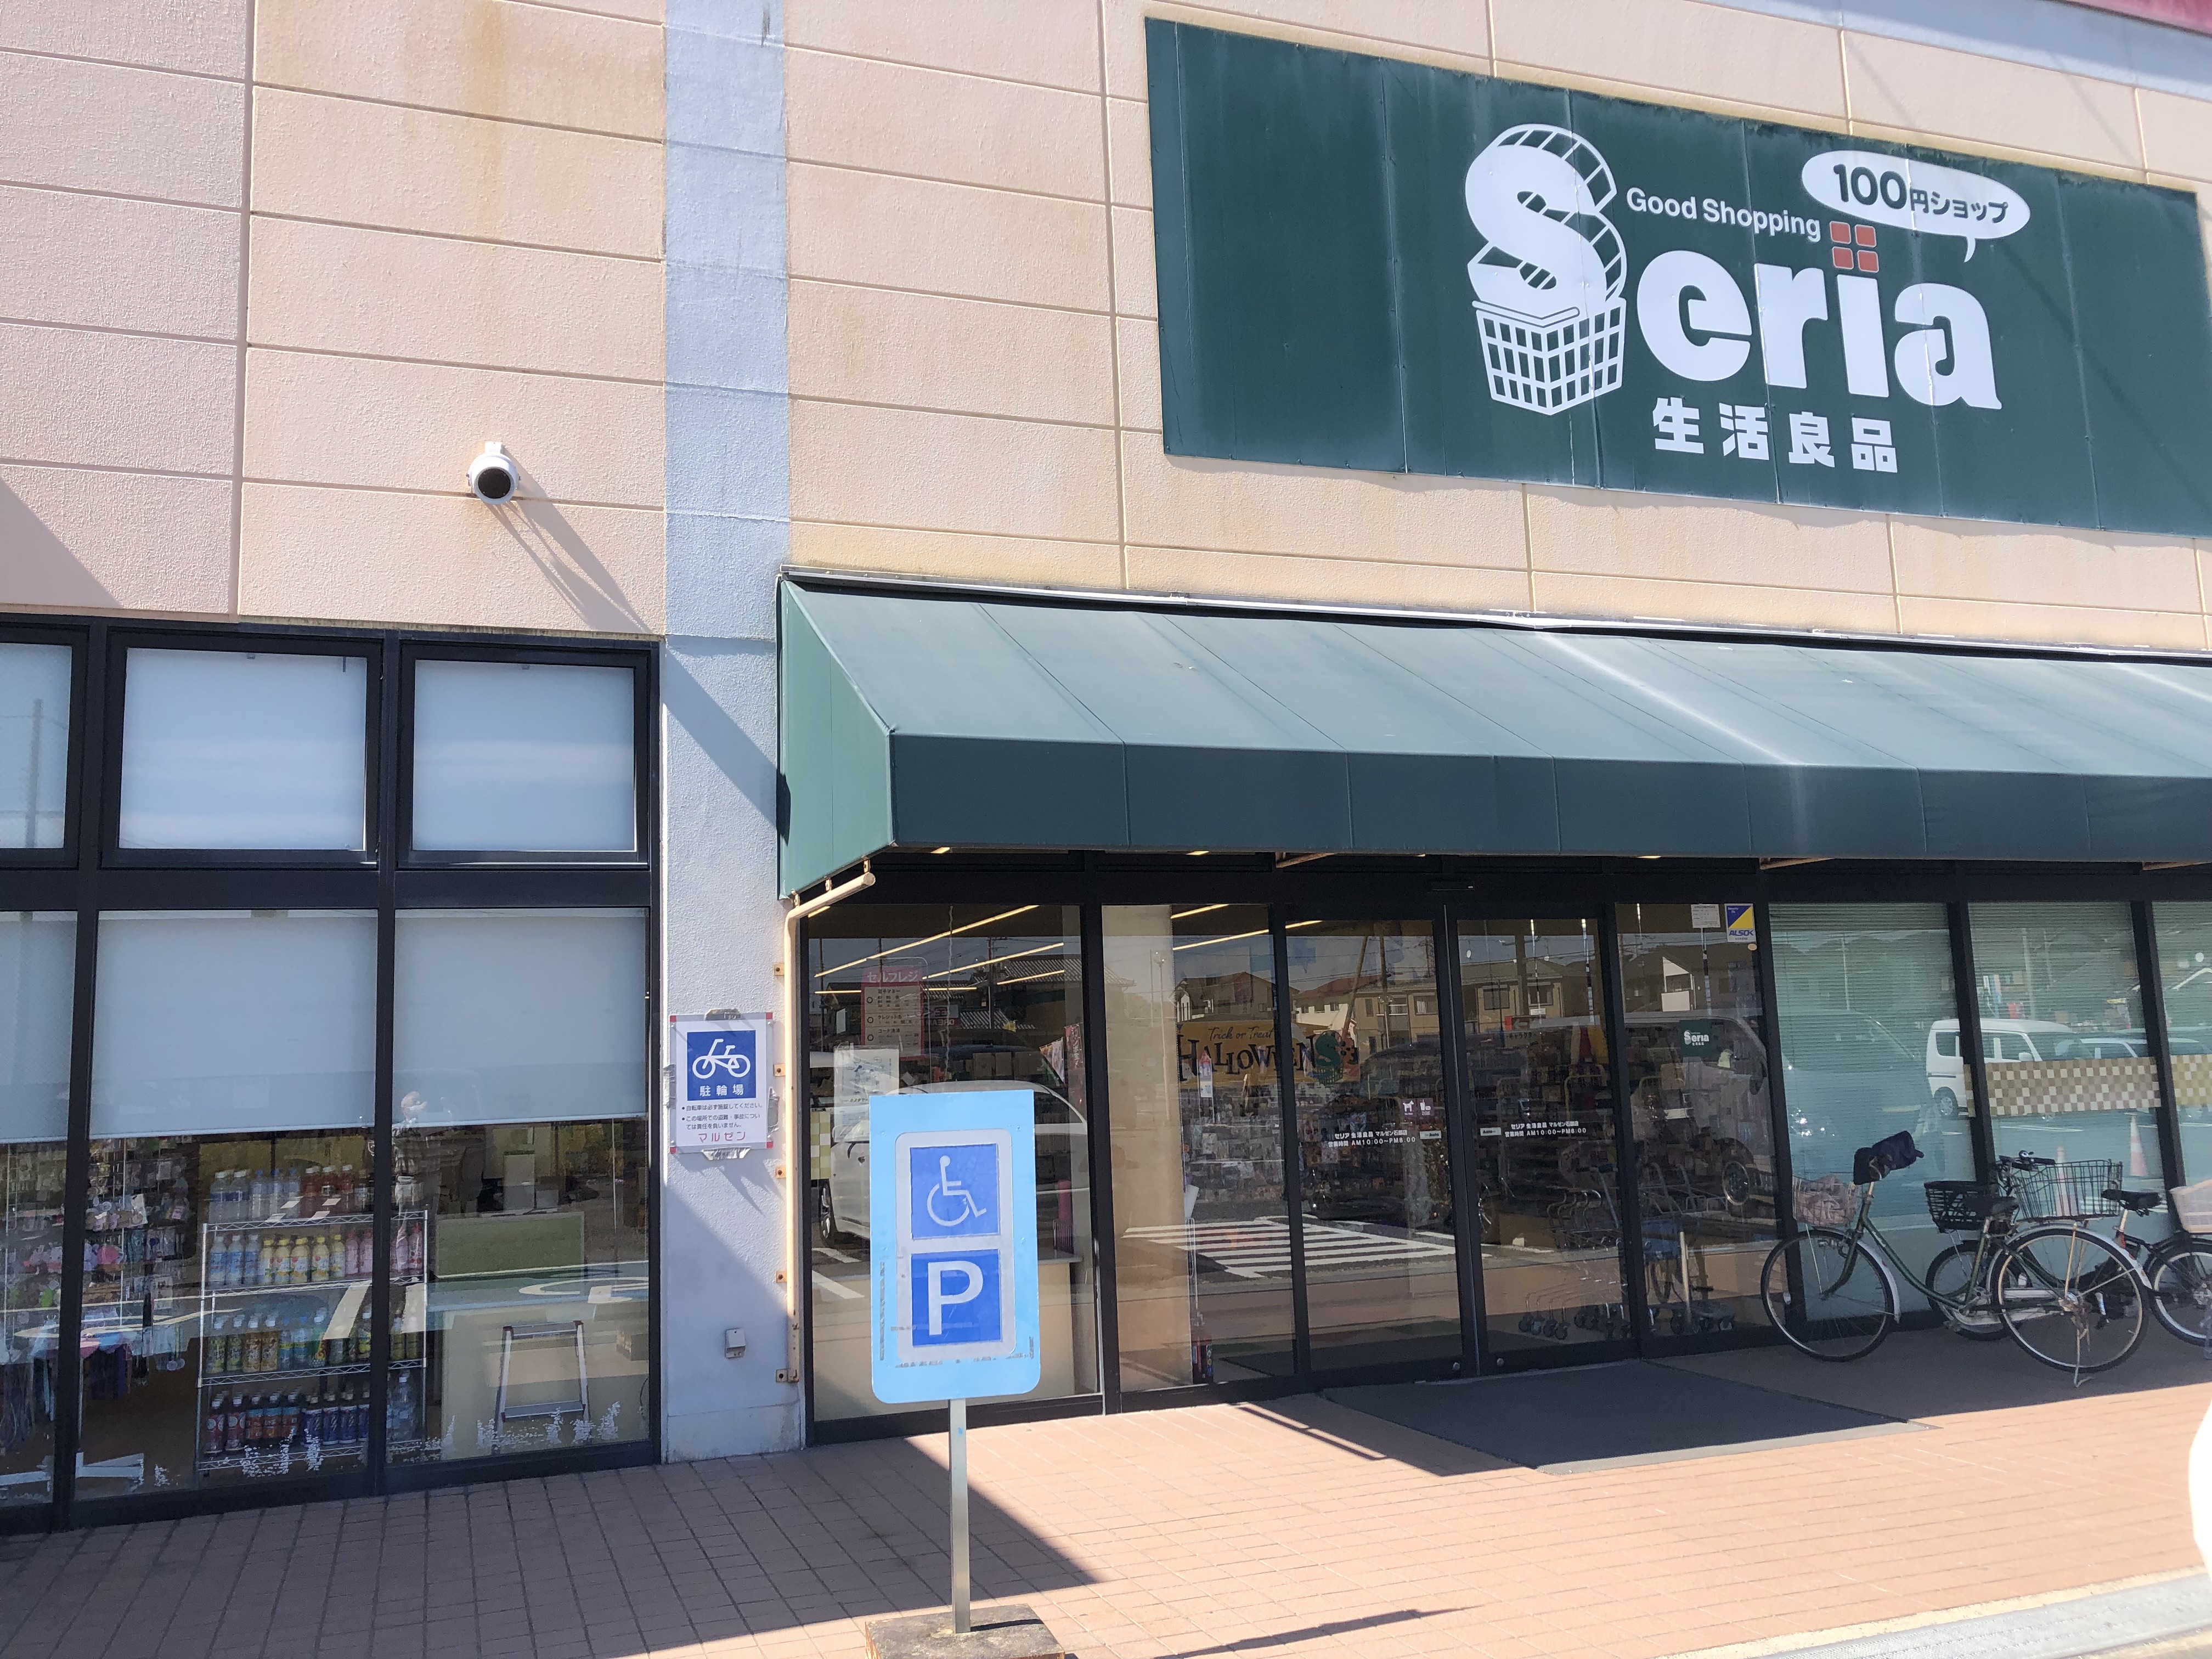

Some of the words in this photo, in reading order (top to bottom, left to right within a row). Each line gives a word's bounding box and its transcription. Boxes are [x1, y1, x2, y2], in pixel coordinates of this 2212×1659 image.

[1626, 187, 1698, 221] Good
[1703, 199, 1821, 242] Shopping
[1833, 163, 2008, 223] 100円ショップ
[1465, 123, 2002, 415] Seria
[1652, 397, 1898, 473] 生活良品
[867, 969, 918, 983] セルフレジ
[1209, 1026, 1234, 1041] Trick
[1684, 1029, 1709, 1045] Seria
[1178, 1034, 1316, 1082] HALLOWN
[699, 1084, 744, 1097] 駐輪場
[698, 1131, 746, 1143] マルゼン
[928, 1261, 984, 1336] P
